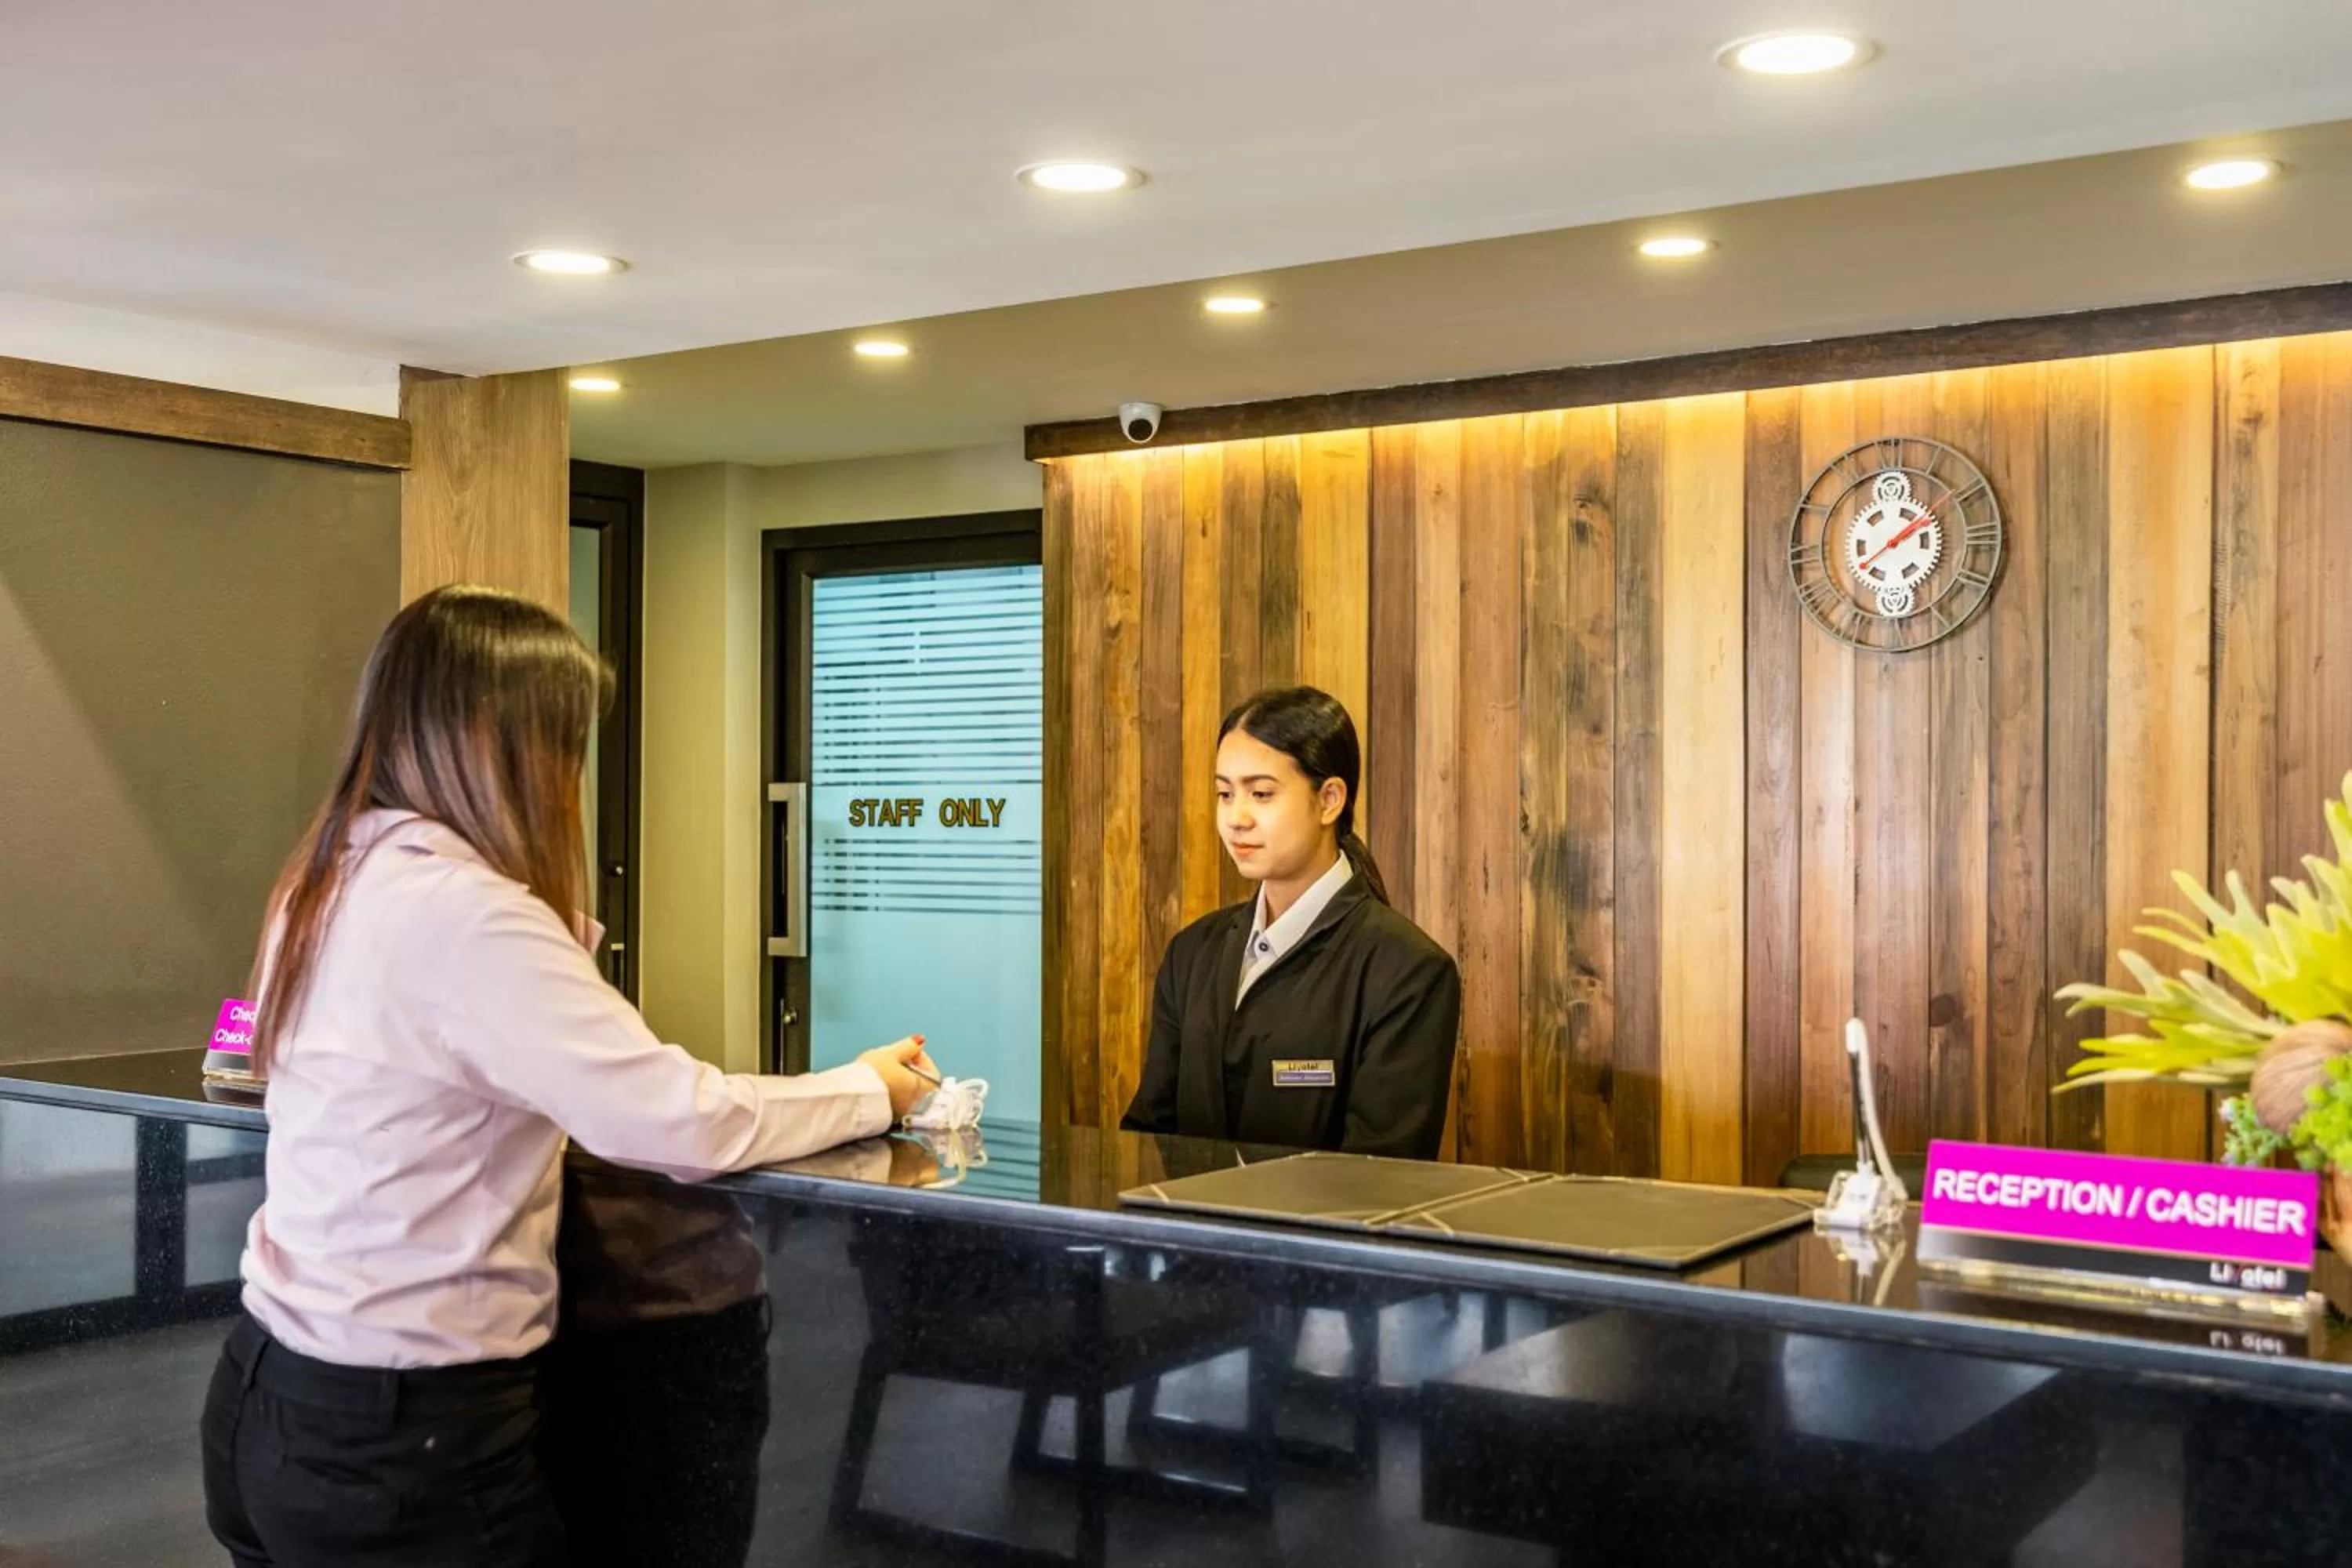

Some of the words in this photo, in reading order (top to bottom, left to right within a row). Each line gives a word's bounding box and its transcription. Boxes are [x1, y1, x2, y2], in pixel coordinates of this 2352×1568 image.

[848, 798, 924, 827] STAFF
[938, 798, 1006, 827] ONLY
[1933, 1167, 2124, 1217] RECEPTION
[2125, 1185, 2145, 1219] /
[2145, 1187, 2308, 1237] CASHIER
